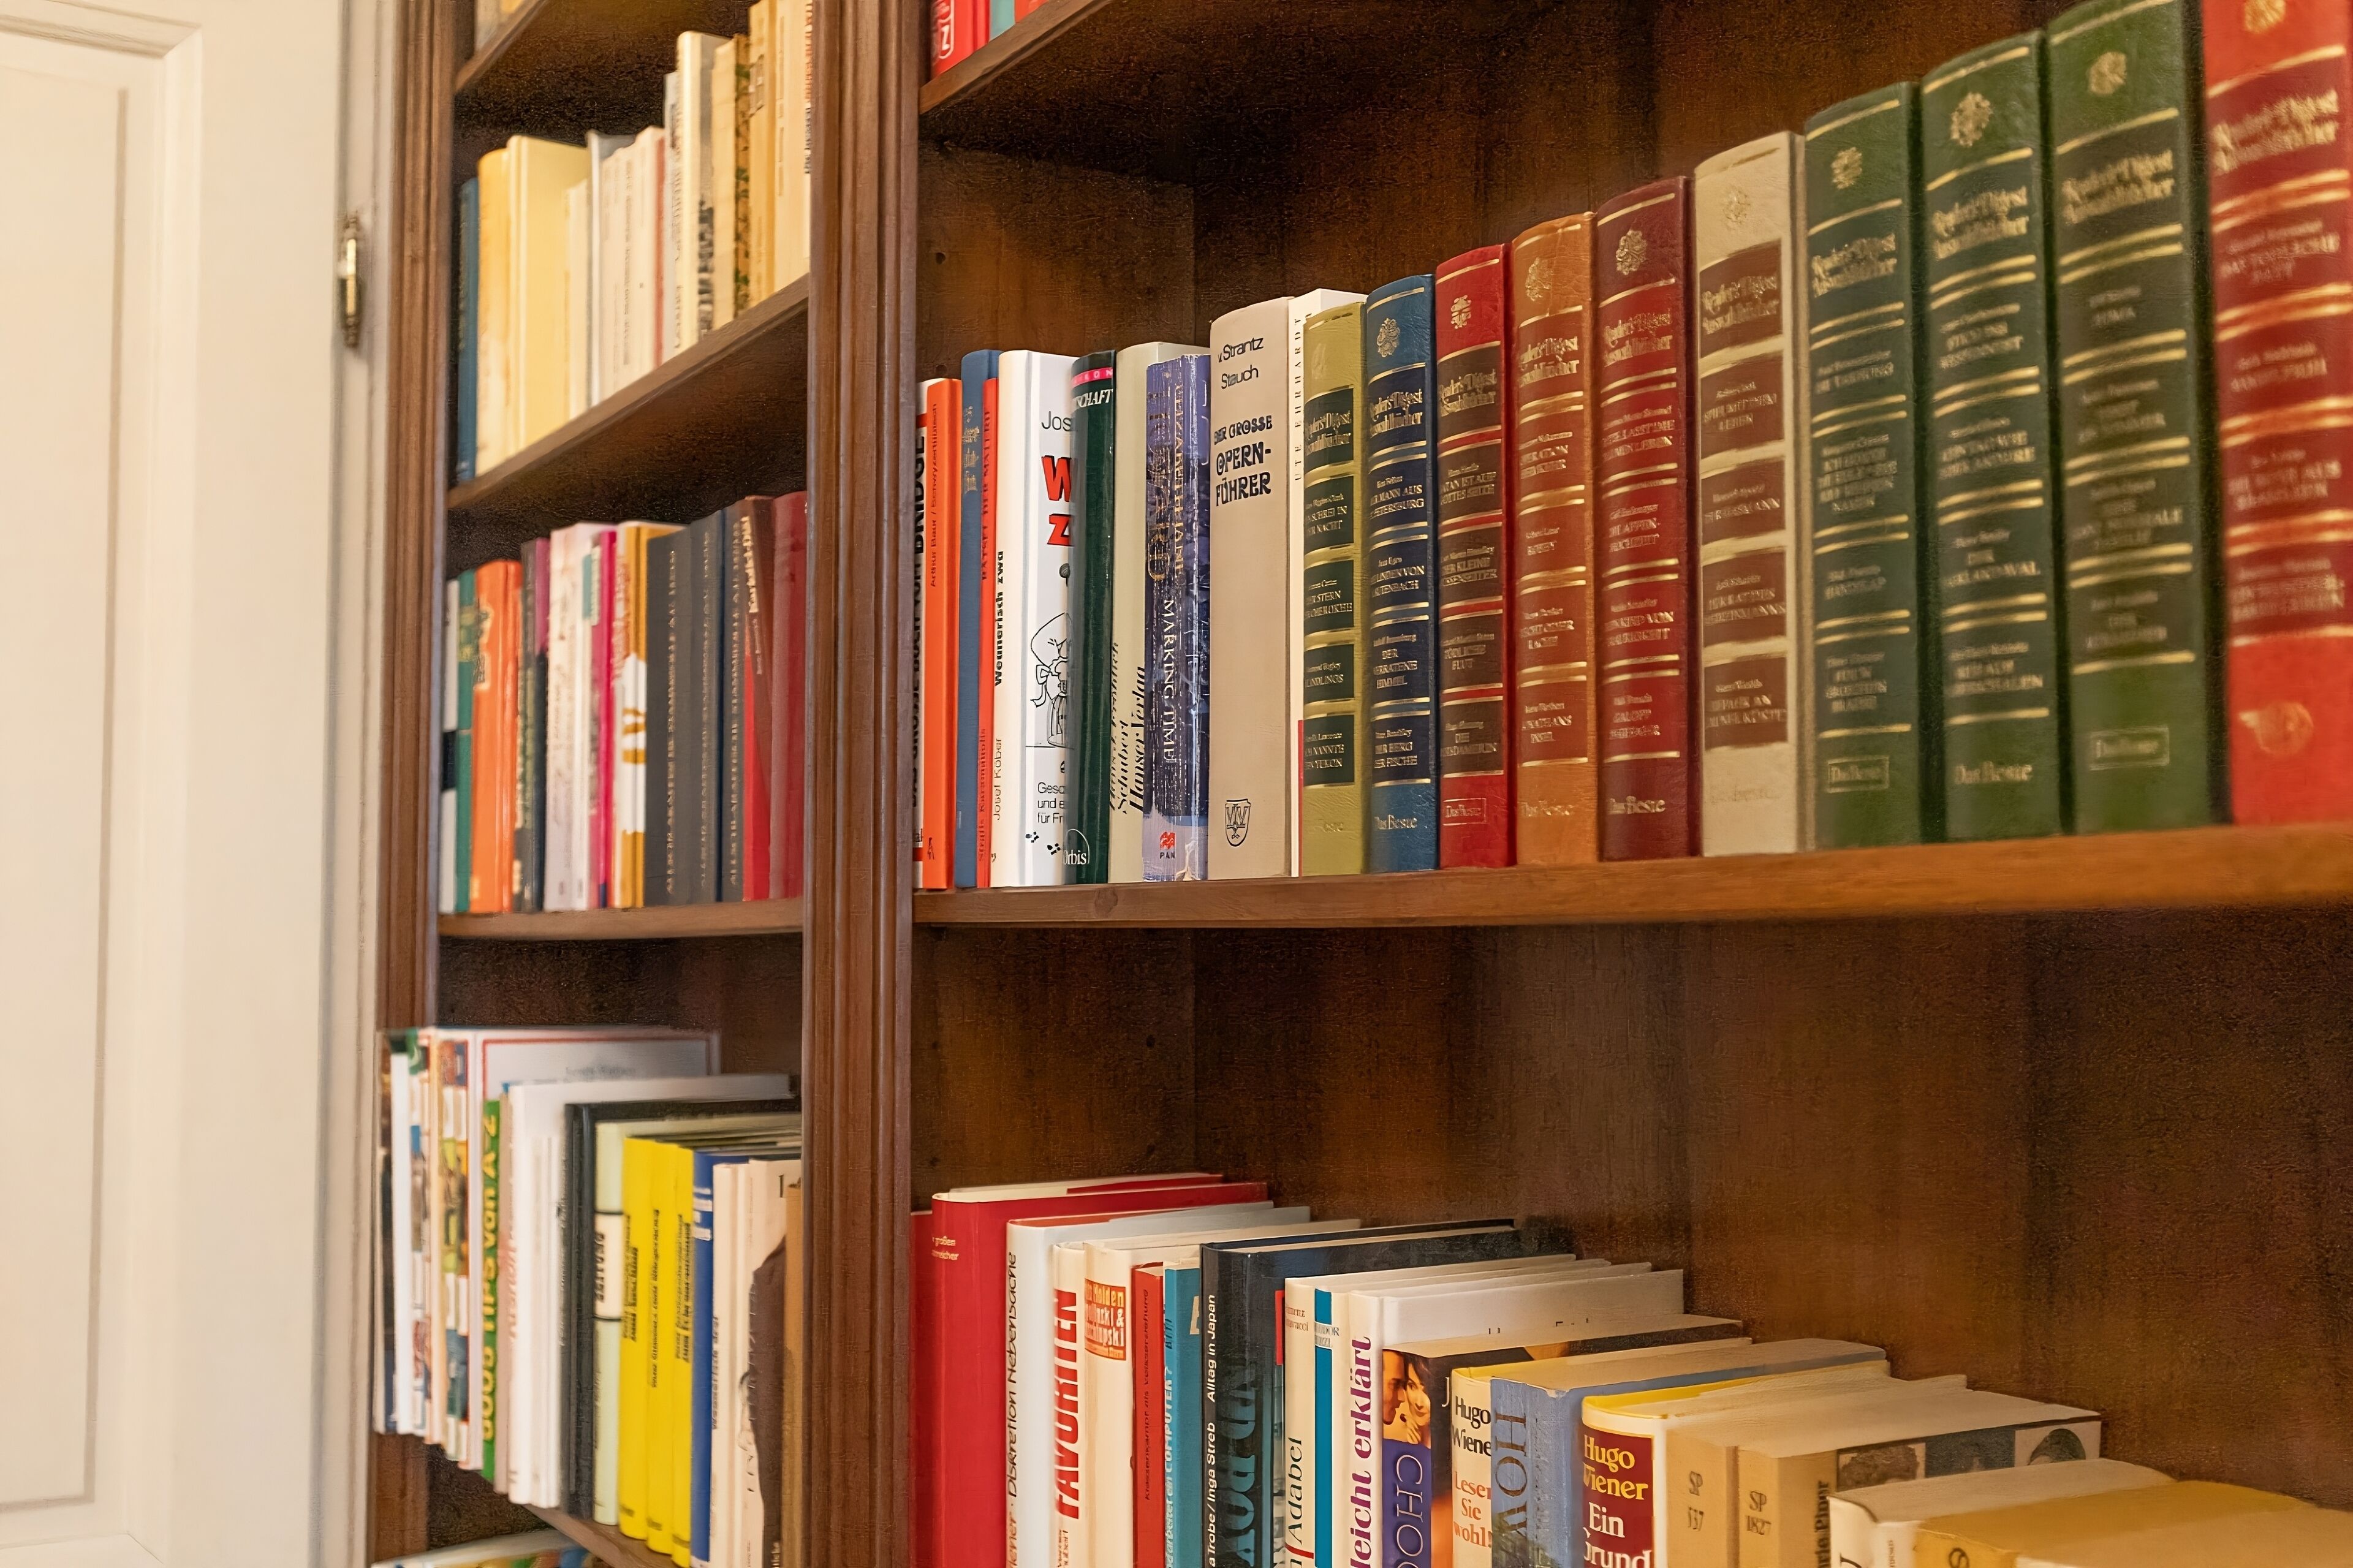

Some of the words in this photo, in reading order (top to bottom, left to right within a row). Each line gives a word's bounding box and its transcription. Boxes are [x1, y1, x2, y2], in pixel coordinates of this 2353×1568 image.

[1229, 415, 1273, 438] GROSSE
[1216, 441, 1271, 475] OPERN-
[1216, 471, 1271, 507] FÜHRER
[1163, 599, 1175, 698] MARKING
[1163, 709, 1176, 763] TIME
[1118, 719, 1129, 814] Schubert
[1130, 733, 1145, 812] Hanser
[1038, 798, 1056, 809] und
[1038, 812, 1050, 824] für
[1053, 812, 1063, 824] Fr
[1064, 849, 1087, 865] Orbis
[1006, 1251, 1017, 1384] Nebensache
[1206, 1295, 1217, 1340] Japan
[1207, 1343, 1216, 1355] in
[1207, 1360, 1217, 1402] Alltag
[1350, 1336, 1372, 1459] erklärt
[1054, 1288, 1079, 1519] FAVORITEN
[1455, 1396, 1491, 1429] Hugo
[1007, 1390, 1017, 1498] Diskretion
[1206, 1423, 1215, 1464] Streb
[1452, 1426, 1491, 1456] Wiene
[1584, 1434, 1635, 1473] Hugo
[1207, 1468, 1217, 1502] Inga
[1350, 1470, 1372, 1568] leicht
[1396, 1455, 1423, 1568] CHO
[1461, 1497, 1482, 1521] Sie
[1589, 1502, 1625, 1538] Ein
[1207, 1515, 1216, 1554] Trobe
